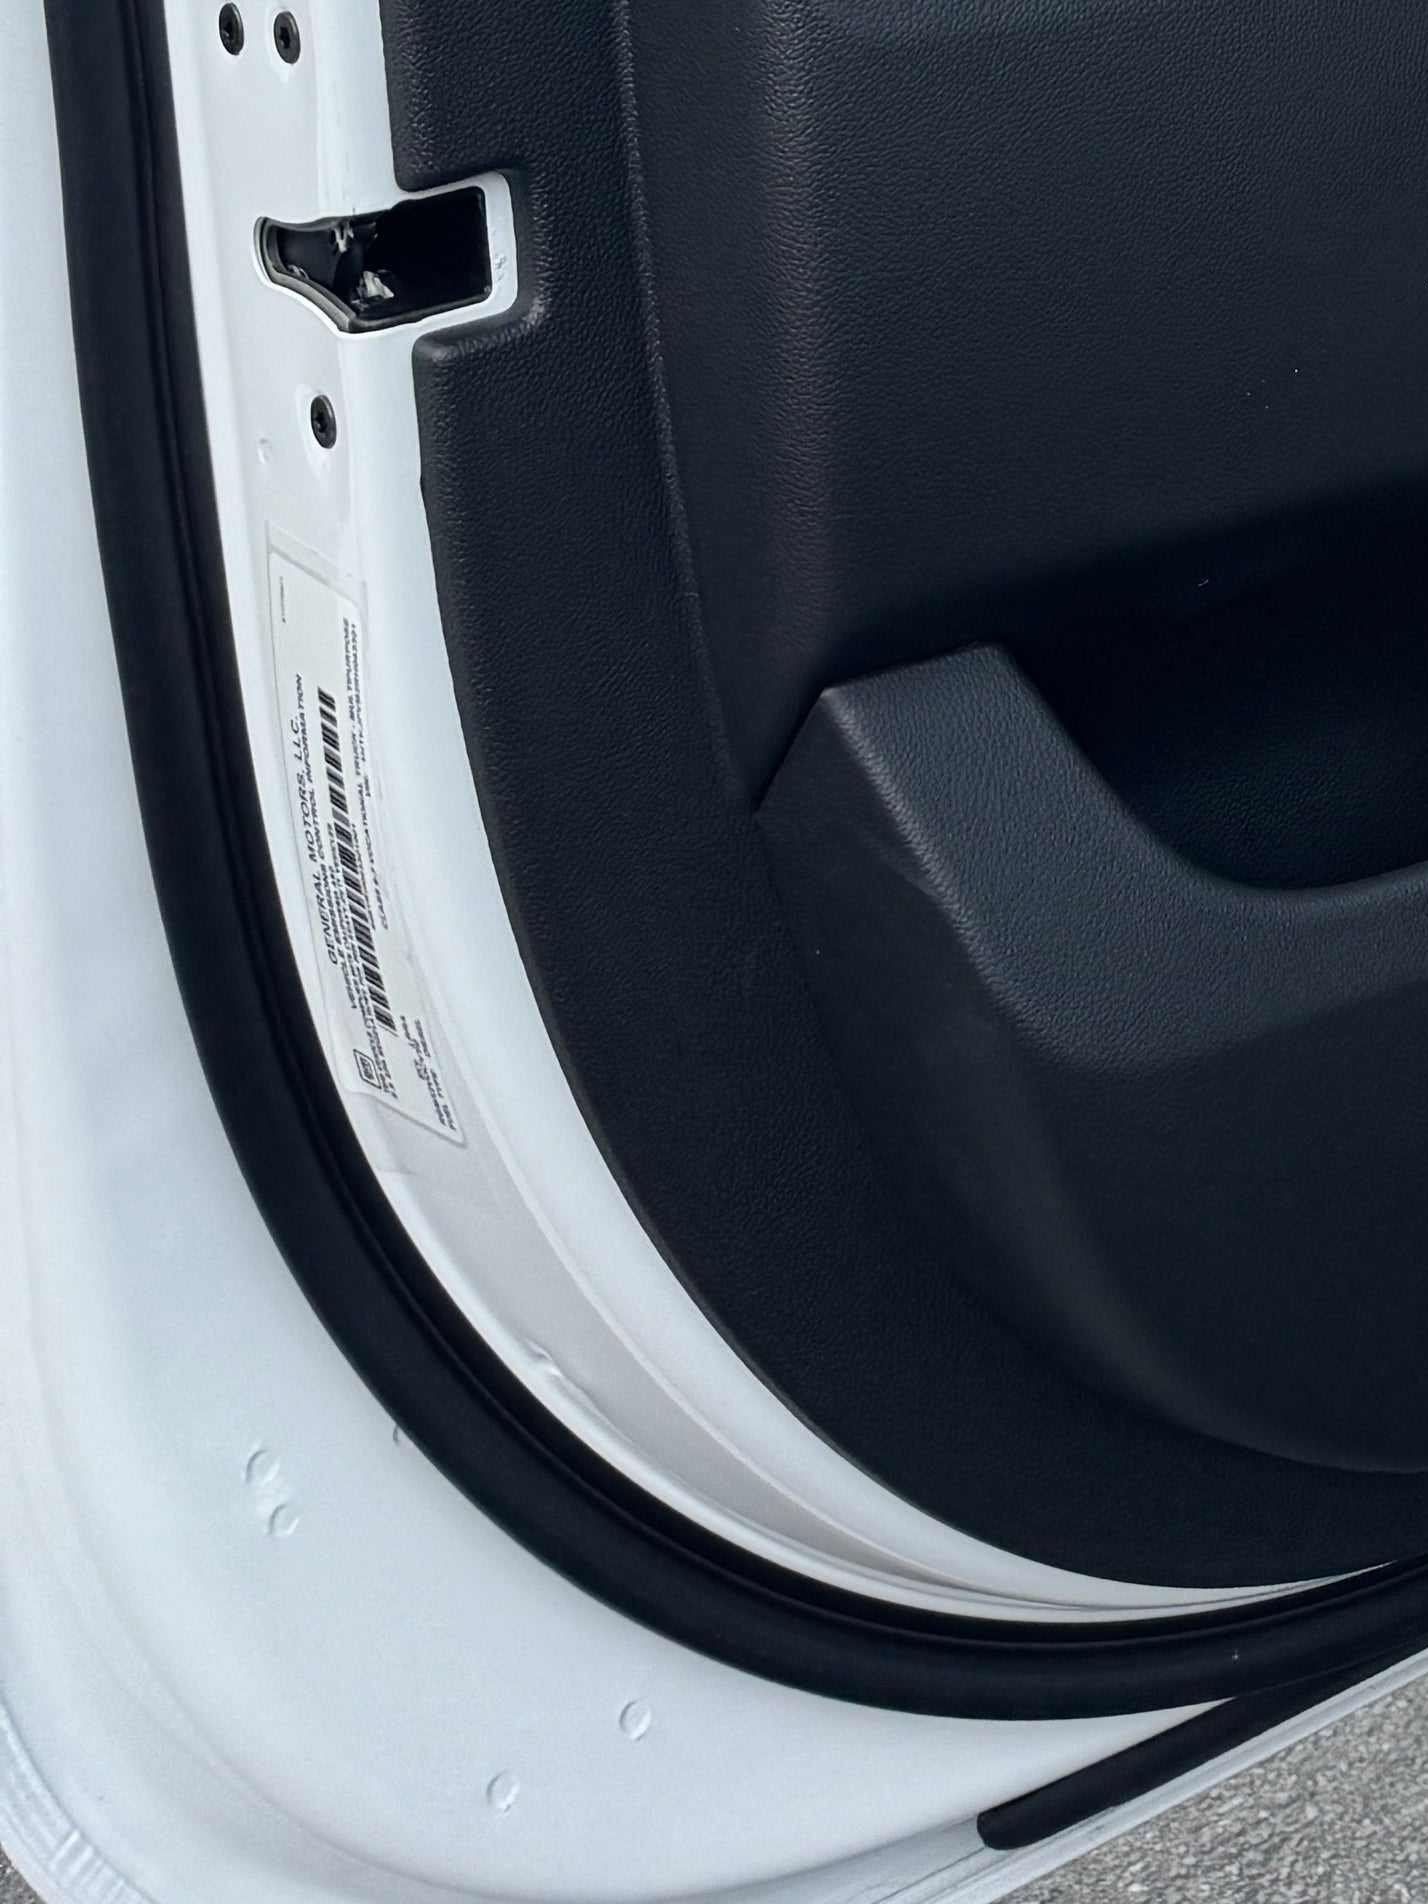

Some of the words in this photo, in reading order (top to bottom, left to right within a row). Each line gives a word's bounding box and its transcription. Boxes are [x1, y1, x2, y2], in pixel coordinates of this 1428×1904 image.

[295, 672, 313, 783] INFORMATION
[306, 784, 325, 859] CONTROL
[310, 866, 338, 964] GENERAL
